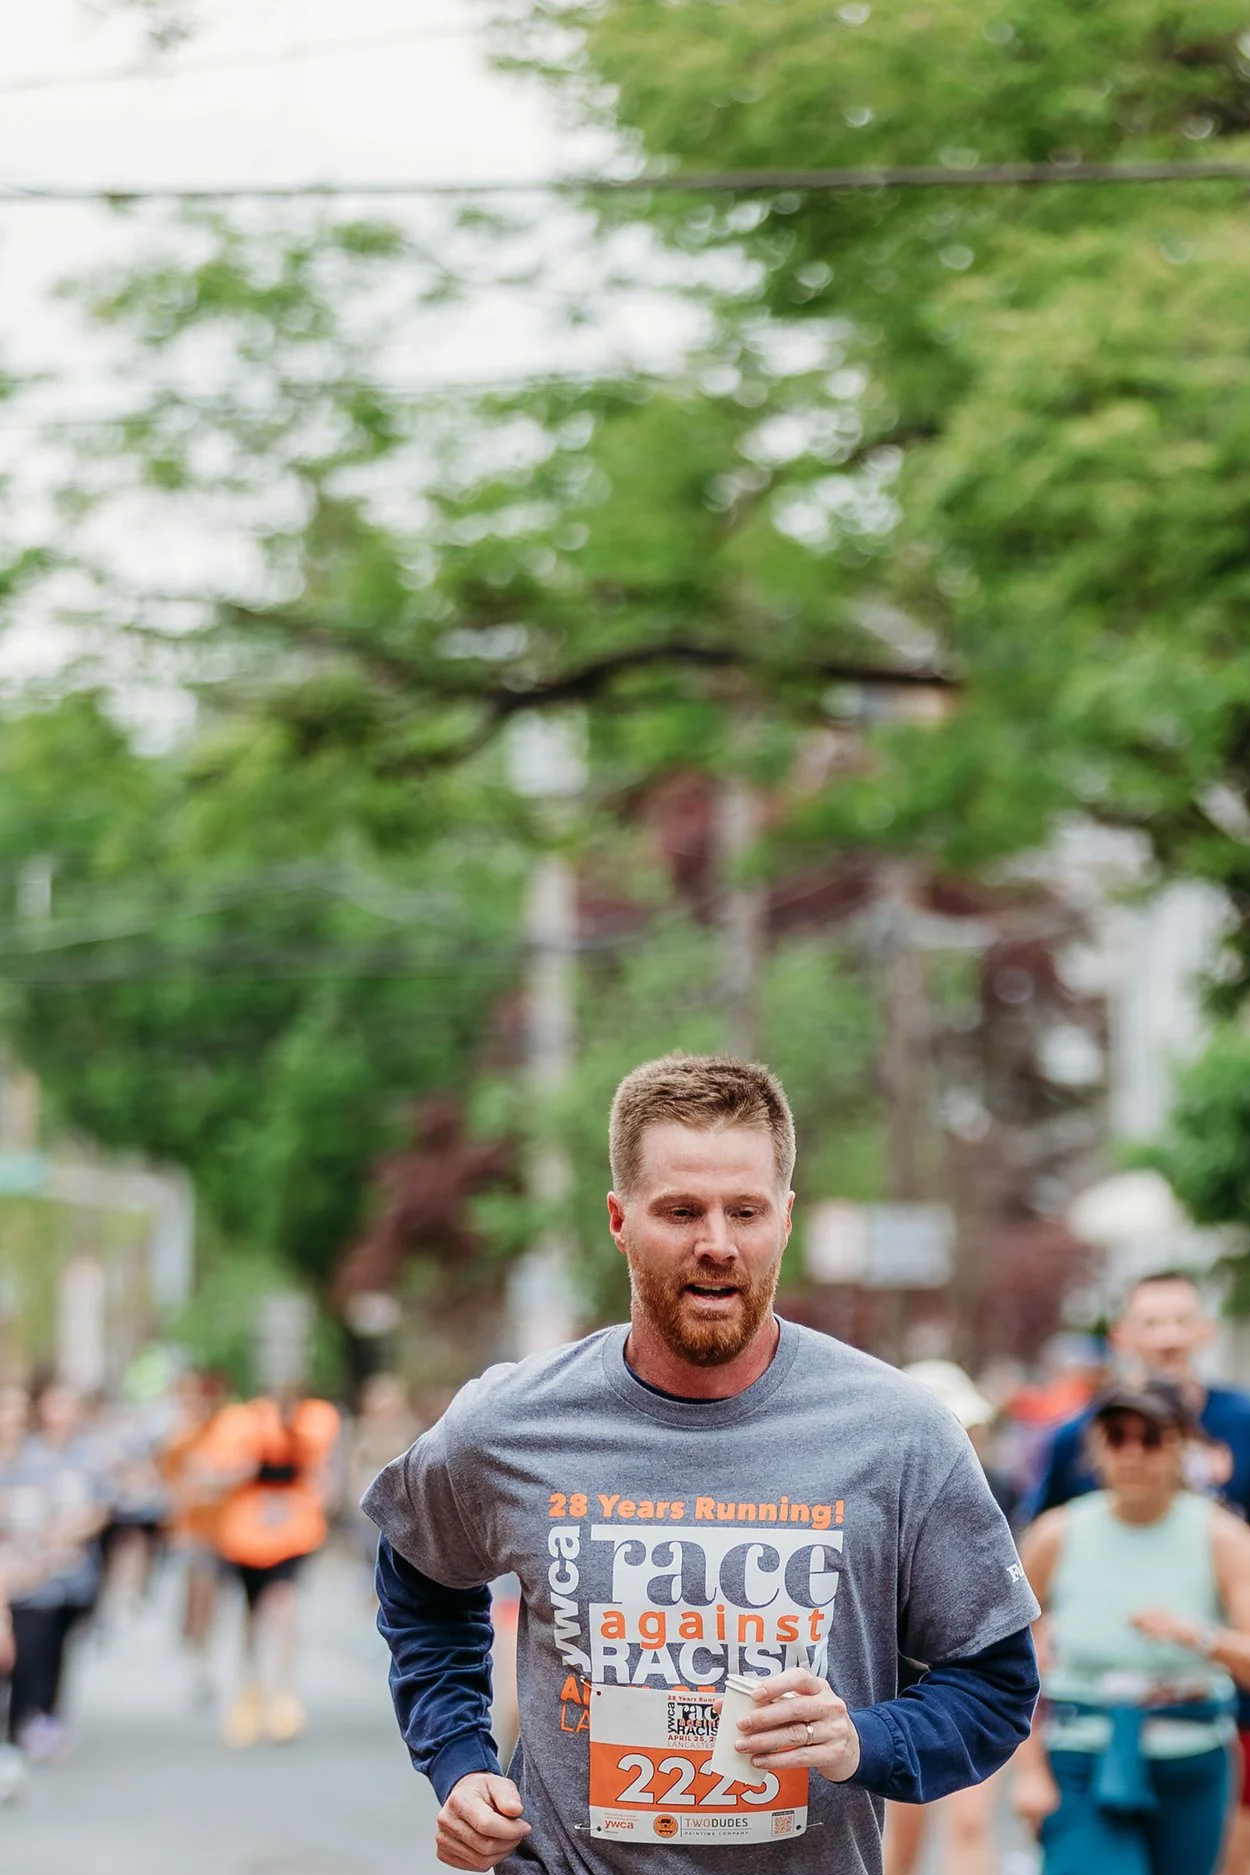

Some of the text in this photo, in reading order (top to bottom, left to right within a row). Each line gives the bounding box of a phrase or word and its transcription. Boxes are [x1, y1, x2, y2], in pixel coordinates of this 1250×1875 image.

[548, 1493, 845, 1530] 28 Years Running!
[591, 1528, 843, 1609] race
[547, 1525, 592, 1673] ywca
[600, 1604, 826, 1650] against
[667, 1702, 678, 1733] ywca
[677, 1725, 719, 1737] RACIS
[668, 1734, 692, 1742] APRIL
[604, 1819, 634, 1829] ywca
